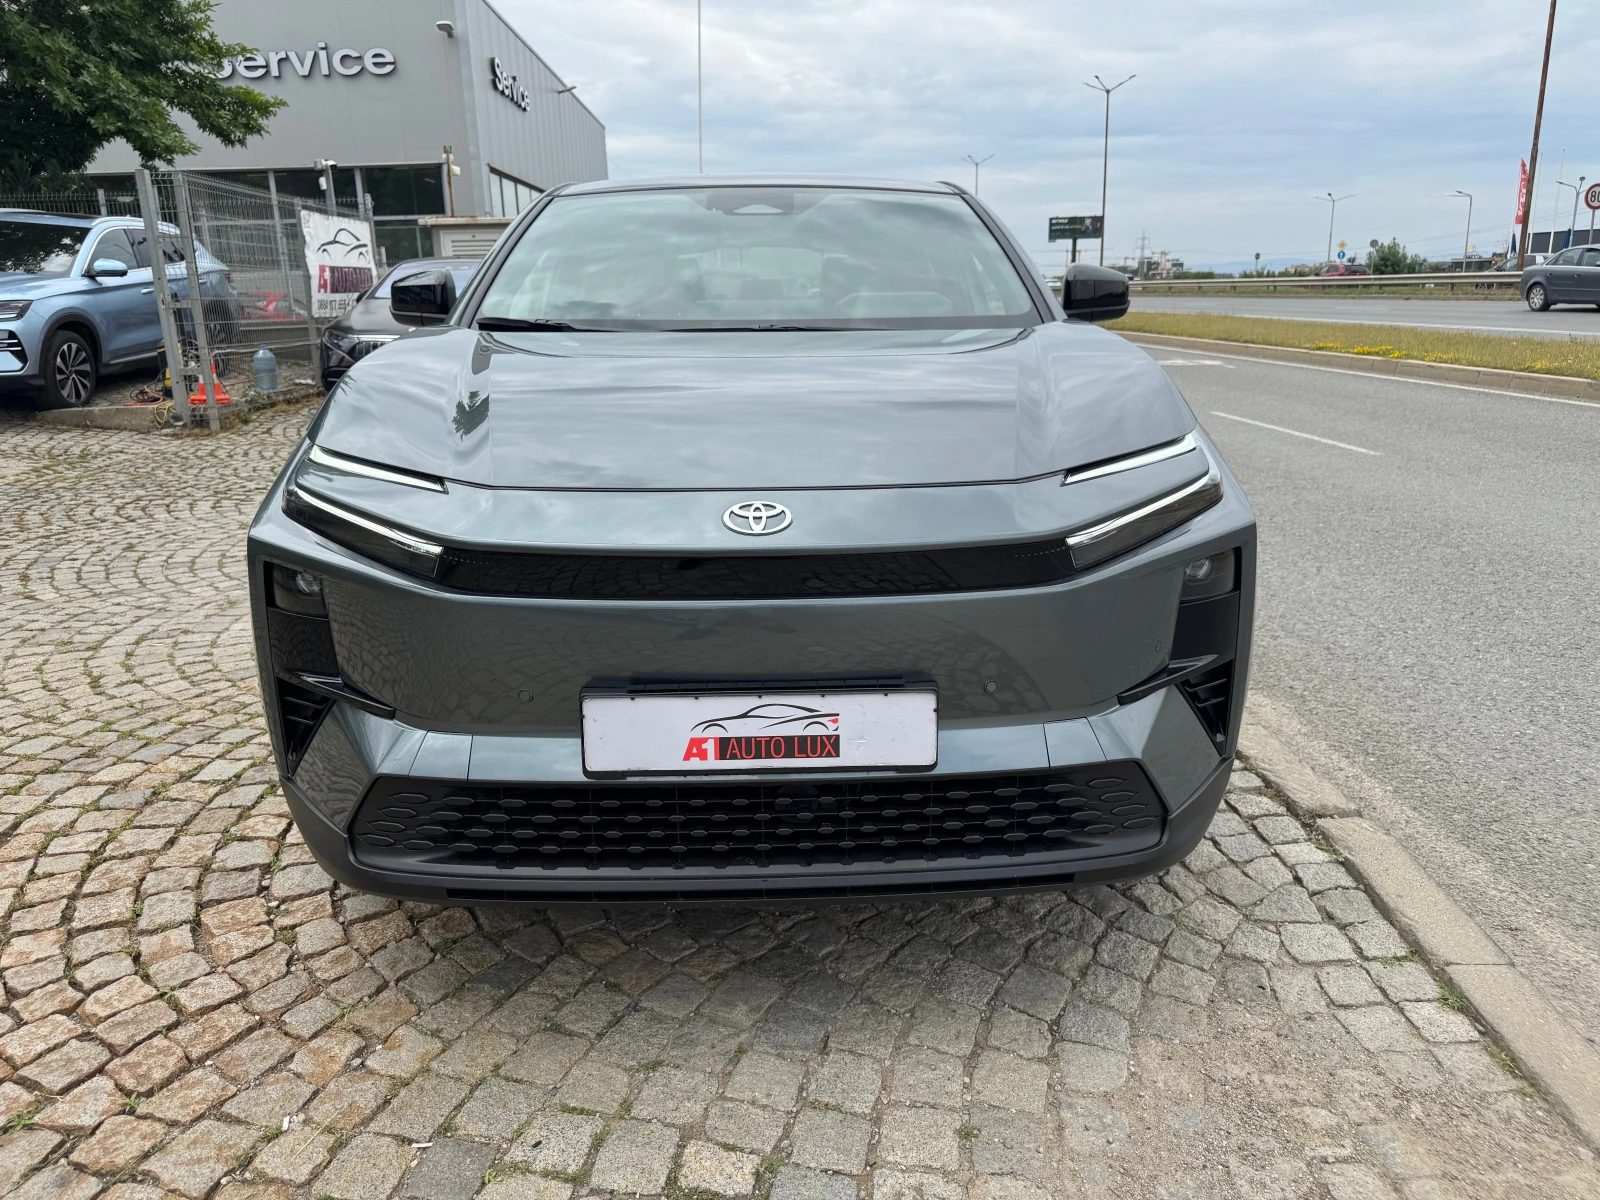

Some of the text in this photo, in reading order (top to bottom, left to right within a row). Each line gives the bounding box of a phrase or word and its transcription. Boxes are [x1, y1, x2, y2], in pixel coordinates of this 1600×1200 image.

[492, 56, 531, 112] Service
[682, 735, 837, 761] A1 AUTO LUX
